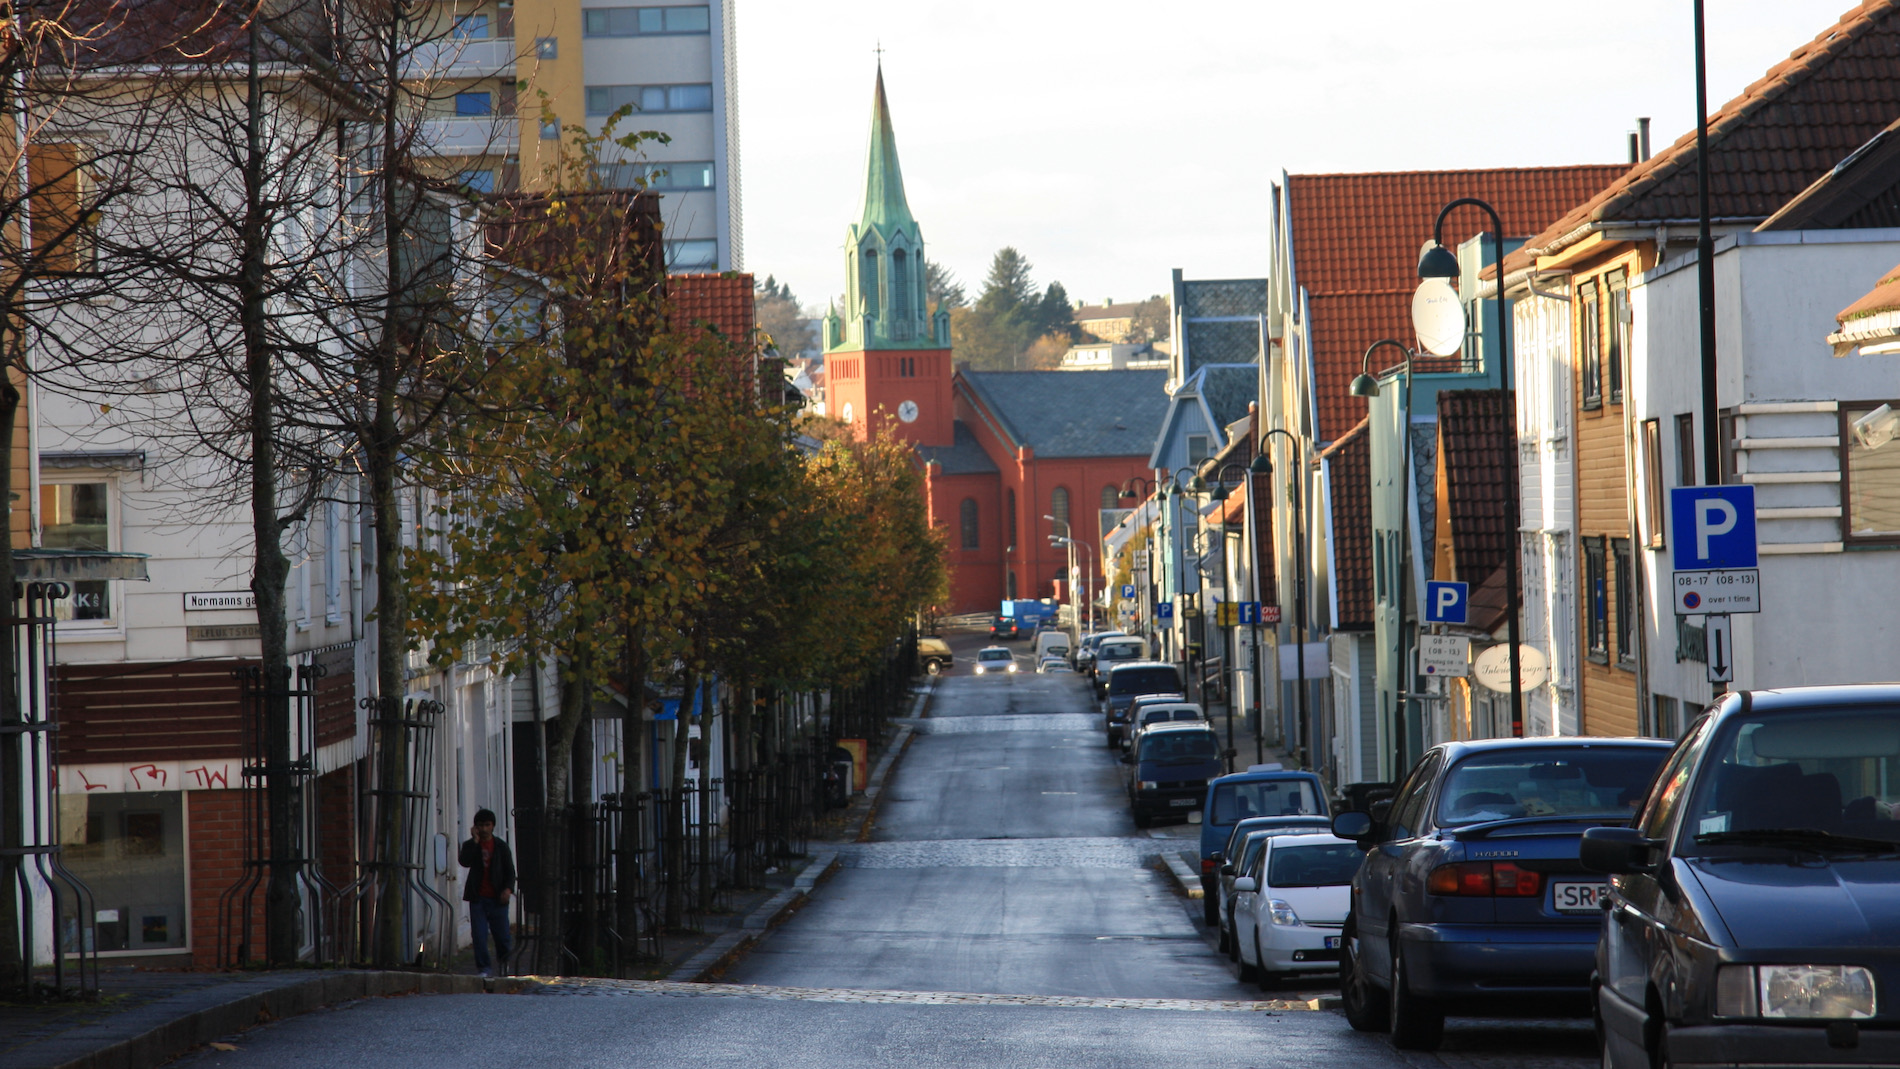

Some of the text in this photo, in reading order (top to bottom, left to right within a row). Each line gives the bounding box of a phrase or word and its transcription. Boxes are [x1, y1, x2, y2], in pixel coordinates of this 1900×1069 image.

[1695, 498, 1738, 560] P
[1124, 586, 1133, 597] P
[191, 595, 257, 607] Normanns ga
[1437, 587, 1459, 618] P
[1161, 604, 1170, 616] P
[1262, 606, 1279, 614] OVE
[1262, 614, 1280, 622] HOP
[1482, 665, 1543, 676] Interio esign
